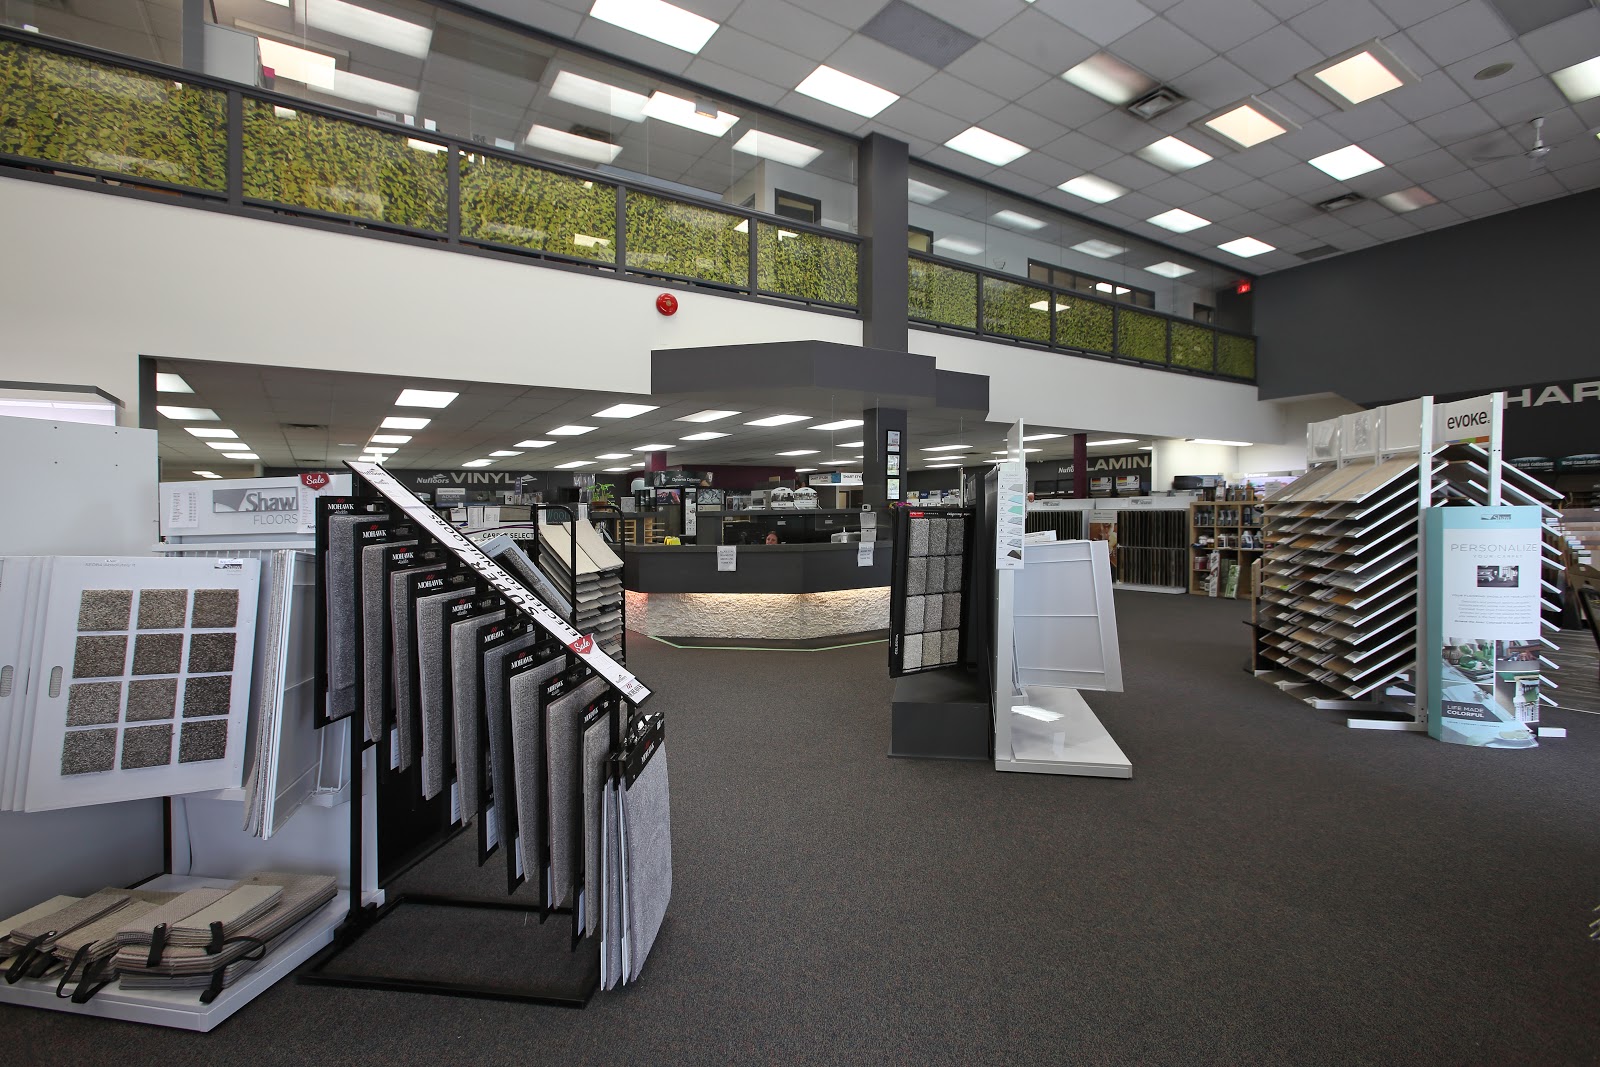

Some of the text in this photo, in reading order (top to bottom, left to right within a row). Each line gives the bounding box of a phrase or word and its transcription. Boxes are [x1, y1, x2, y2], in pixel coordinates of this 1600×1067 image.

[1503, 381, 1600, 409] HAR
[1086, 456, 1152, 471] LAMIN
[306, 475, 325, 485] Sale
[416, 472, 516, 484] Nufloors VINYL
[245, 492, 296, 513] Shaw
[253, 514, 298, 525] FLOORS
[362, 529, 387, 538] MOHAWK
[1450, 543, 1538, 553] PERSONALIZE
[392, 552, 414, 560] MOHAWK
[417, 578, 443, 589] MOHAWK
[497, 570, 524, 590] FOR
[471, 561, 540, 616] SUPER
[451, 602, 473, 613] MOHAWK
[525, 594, 583, 637] ELECTED
[484, 629, 504, 643] MOHAWK
[573, 638, 591, 652] Sale
[510, 655, 533, 669] MOHAWK
[546, 680, 564, 695] MOHAWK
[1446, 710, 1485, 718] COLORFUL
